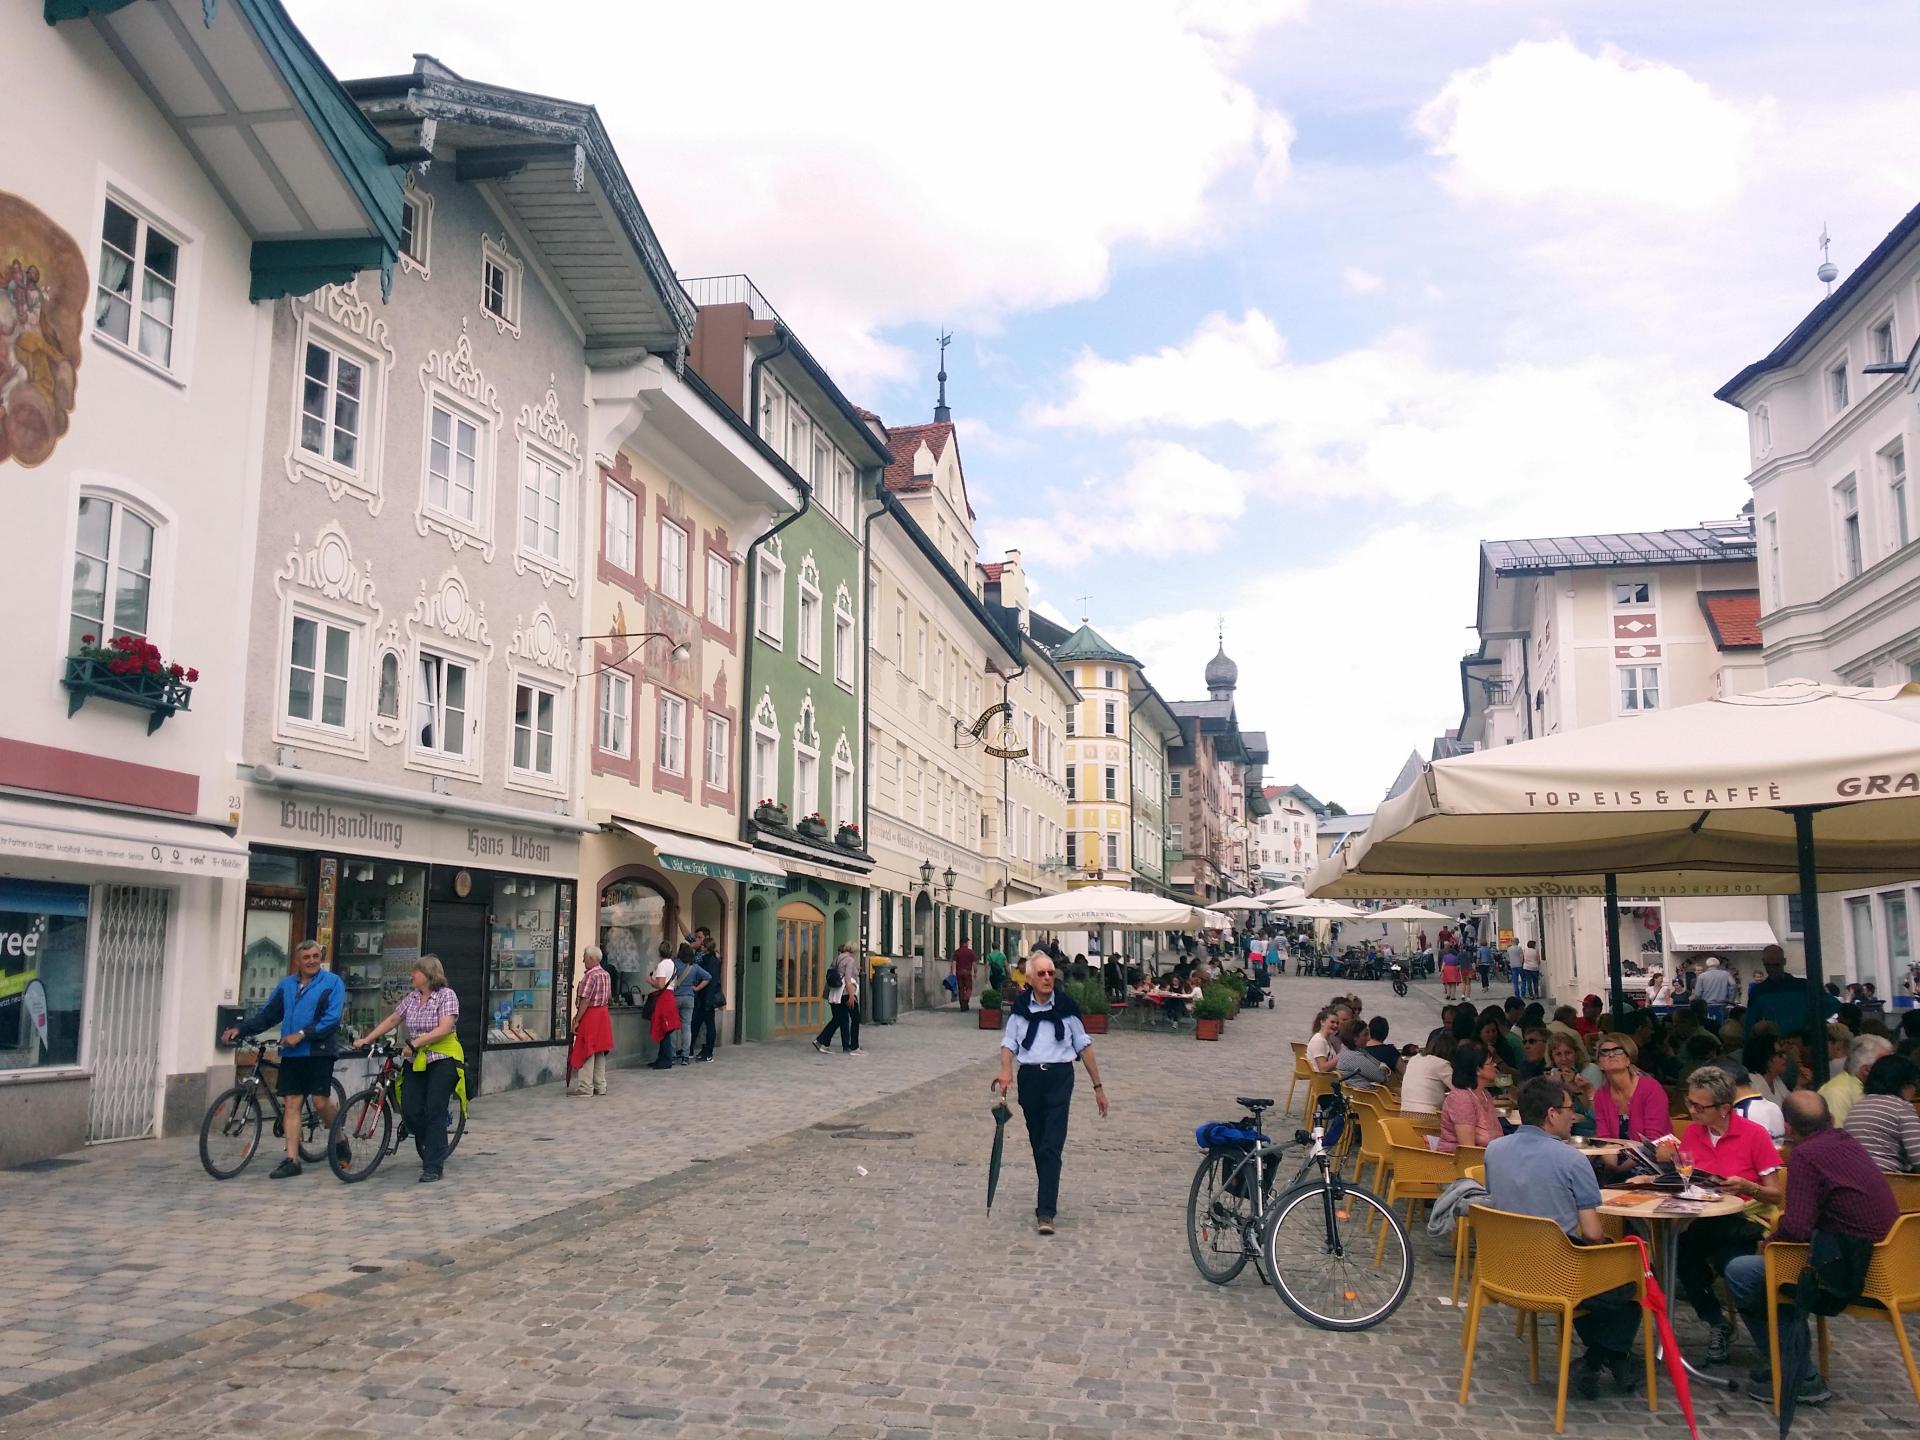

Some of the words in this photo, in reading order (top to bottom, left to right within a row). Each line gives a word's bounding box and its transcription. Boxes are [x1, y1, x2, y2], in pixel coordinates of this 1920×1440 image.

[975, 704, 1003, 732] POSTHOTEL
[229, 796, 241, 809] 23
[1525, 791, 1580, 806] TOP
[1594, 790, 1642, 806] EIS
[1655, 790, 1669, 804] &
[1683, 782, 1780, 804] CAFFÈ
[280, 800, 403, 849] Buchhandlung
[467, 828, 504, 856] Hans
[511, 833, 550, 862] Urban
